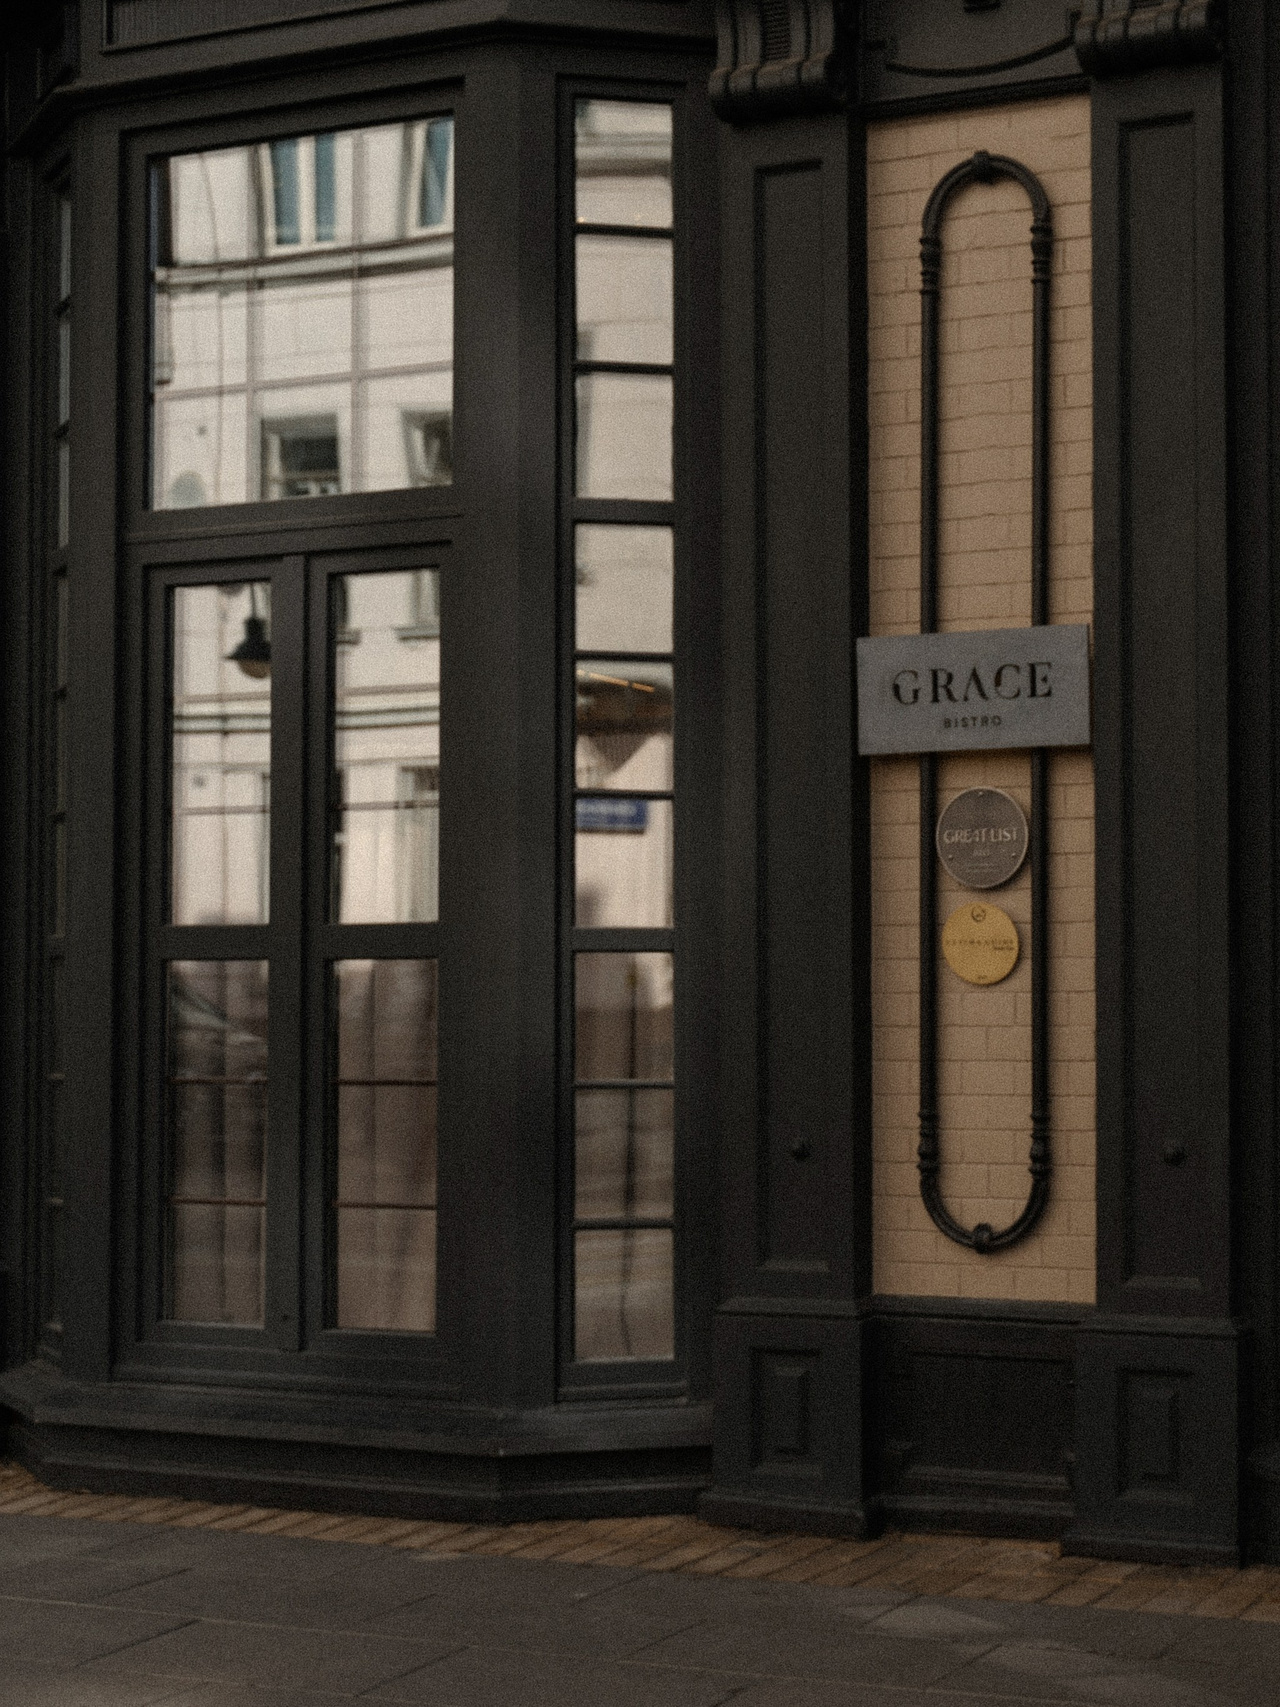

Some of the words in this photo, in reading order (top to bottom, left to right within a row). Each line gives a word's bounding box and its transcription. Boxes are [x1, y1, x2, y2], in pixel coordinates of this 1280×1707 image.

[891, 661, 1053, 706] GRACE
[943, 714, 1003, 730] BISTRO
[943, 827, 988, 844] GREAT
[990, 826, 1018, 843] LIST
